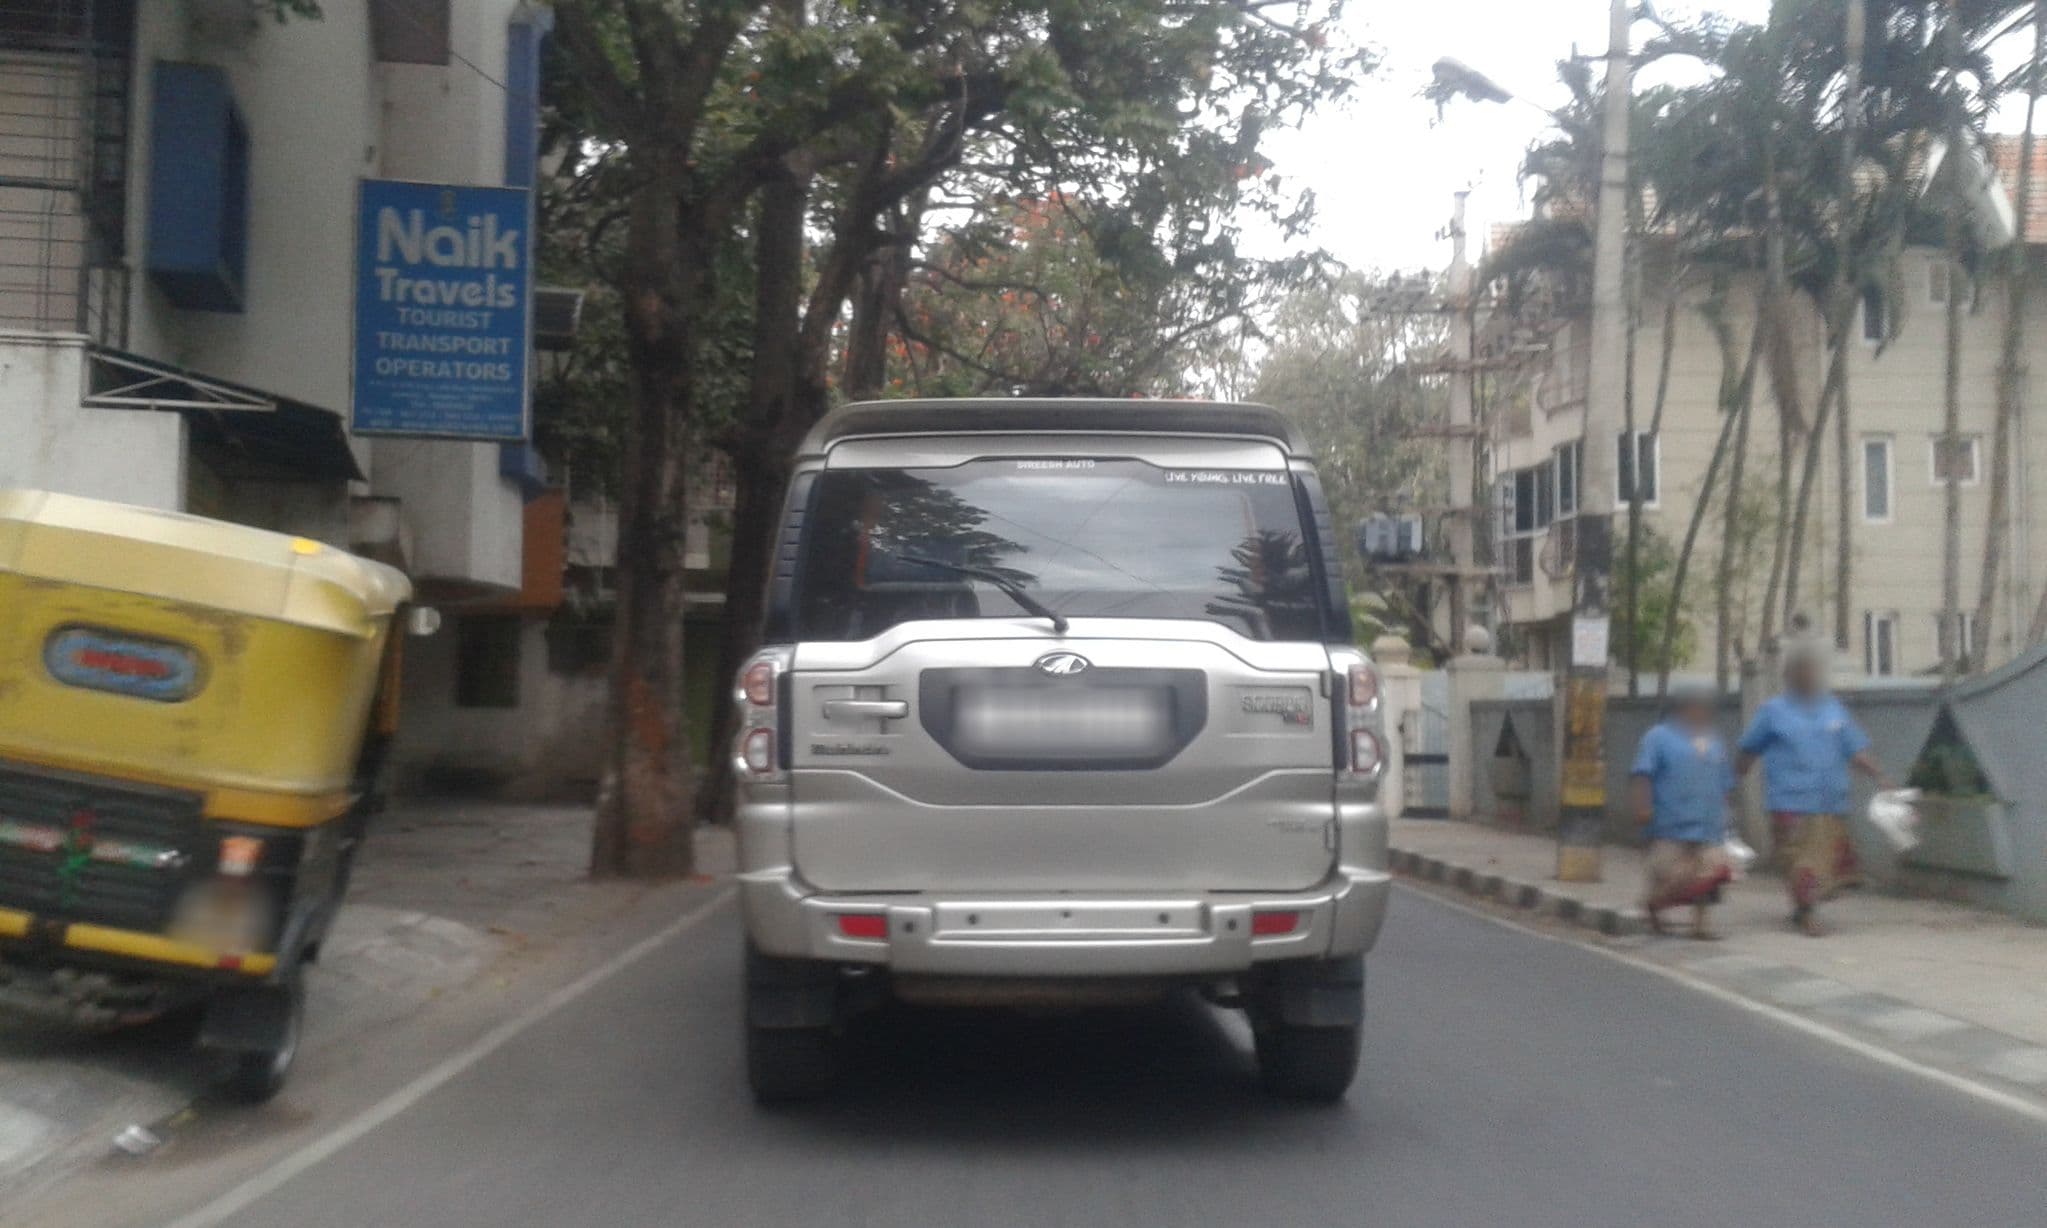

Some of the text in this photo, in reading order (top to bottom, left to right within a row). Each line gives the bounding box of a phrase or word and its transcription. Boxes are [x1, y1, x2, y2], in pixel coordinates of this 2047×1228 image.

[377, 206, 518, 269] Naik
[375, 267, 516, 308] Travels
[397, 307, 493, 329] TOURIST
[376, 331, 512, 355] TRANSPORT
[375, 357, 511, 382] OPERATORS
[1065, 459, 1096, 469] AUTO
[1165, 472, 1188, 483] LIVE
[1232, 473, 1256, 484] LIVE
[1258, 474, 1287, 485] FREE
